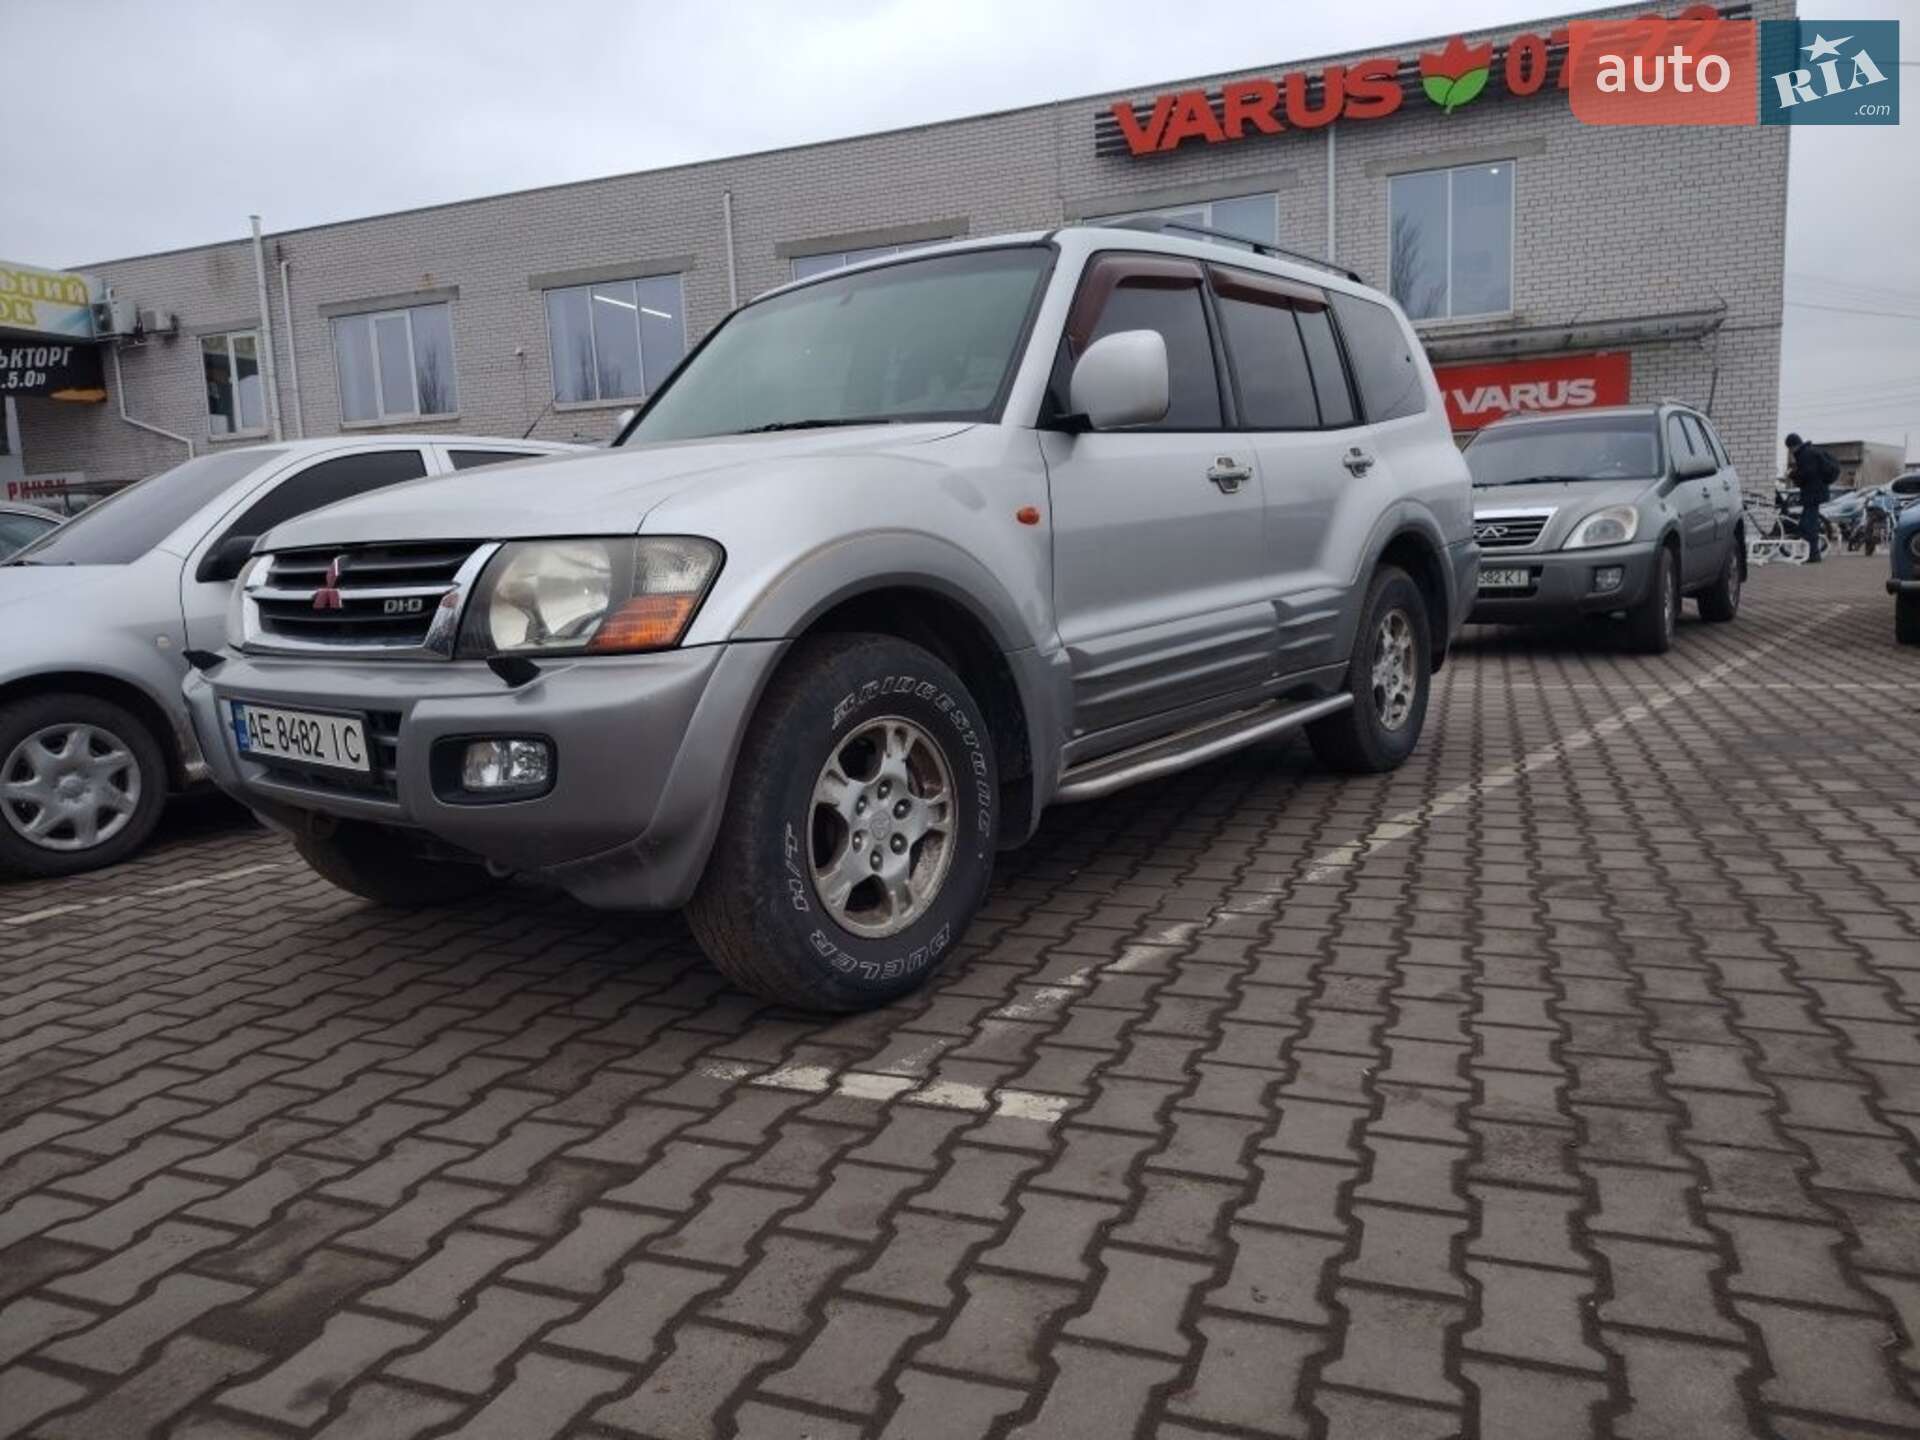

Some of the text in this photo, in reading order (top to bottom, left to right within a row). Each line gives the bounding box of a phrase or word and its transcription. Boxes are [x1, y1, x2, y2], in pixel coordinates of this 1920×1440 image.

[1112, 59, 1403, 155] VARUS
[1452, 378, 1598, 415] VARUS
[248, 712, 361, 763] AE 8482 IC
[809, 921, 952, 980] DUELER
